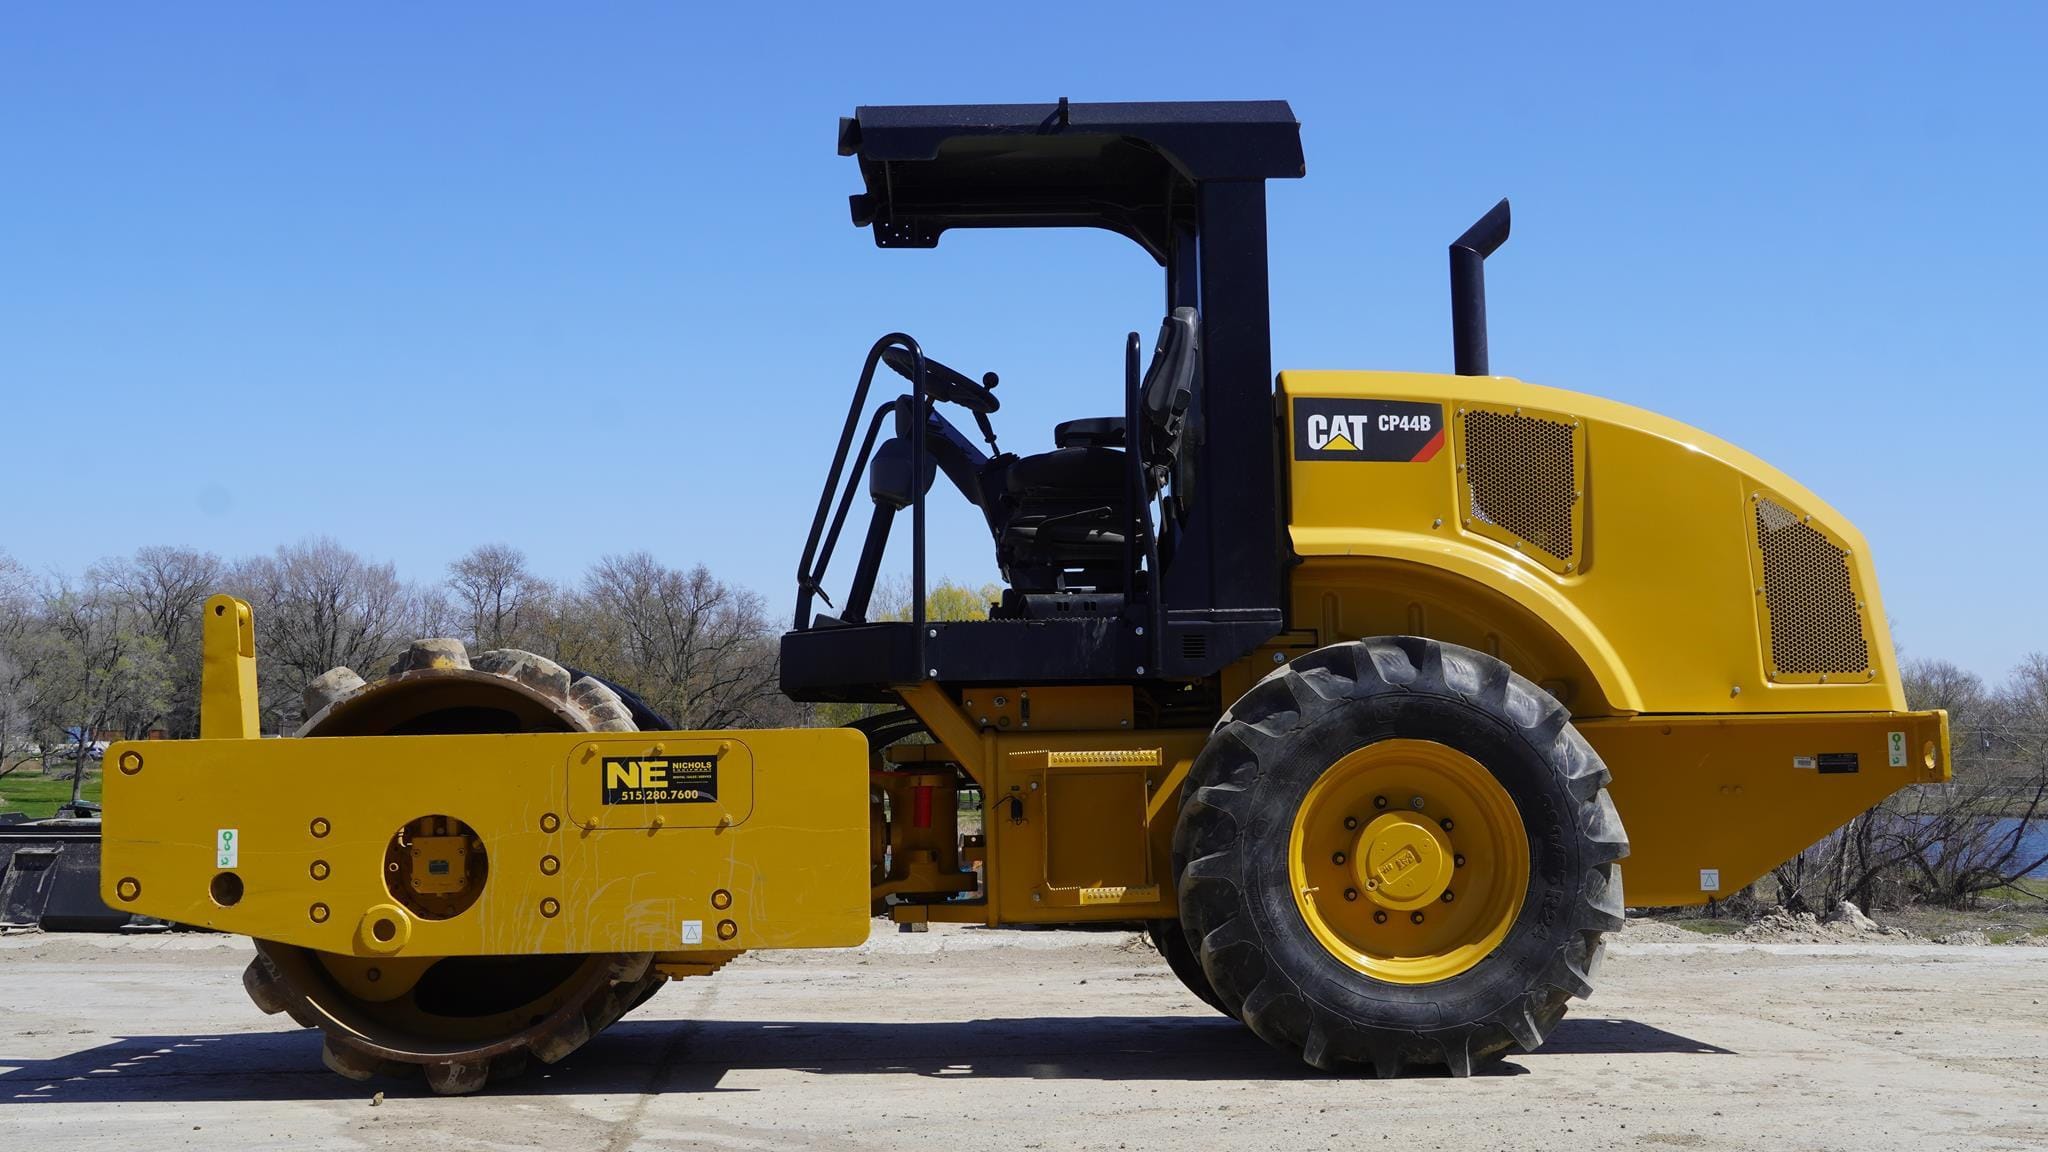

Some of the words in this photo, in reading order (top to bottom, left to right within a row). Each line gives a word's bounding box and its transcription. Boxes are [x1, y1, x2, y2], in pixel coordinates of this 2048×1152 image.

[1307, 414, 1368, 451] CAT
[1378, 415, 1432, 431] CP44B
[607, 761, 668, 789] NE
[672, 761, 712, 769] NICHOLS
[621, 789, 699, 801] 515.280.7600
